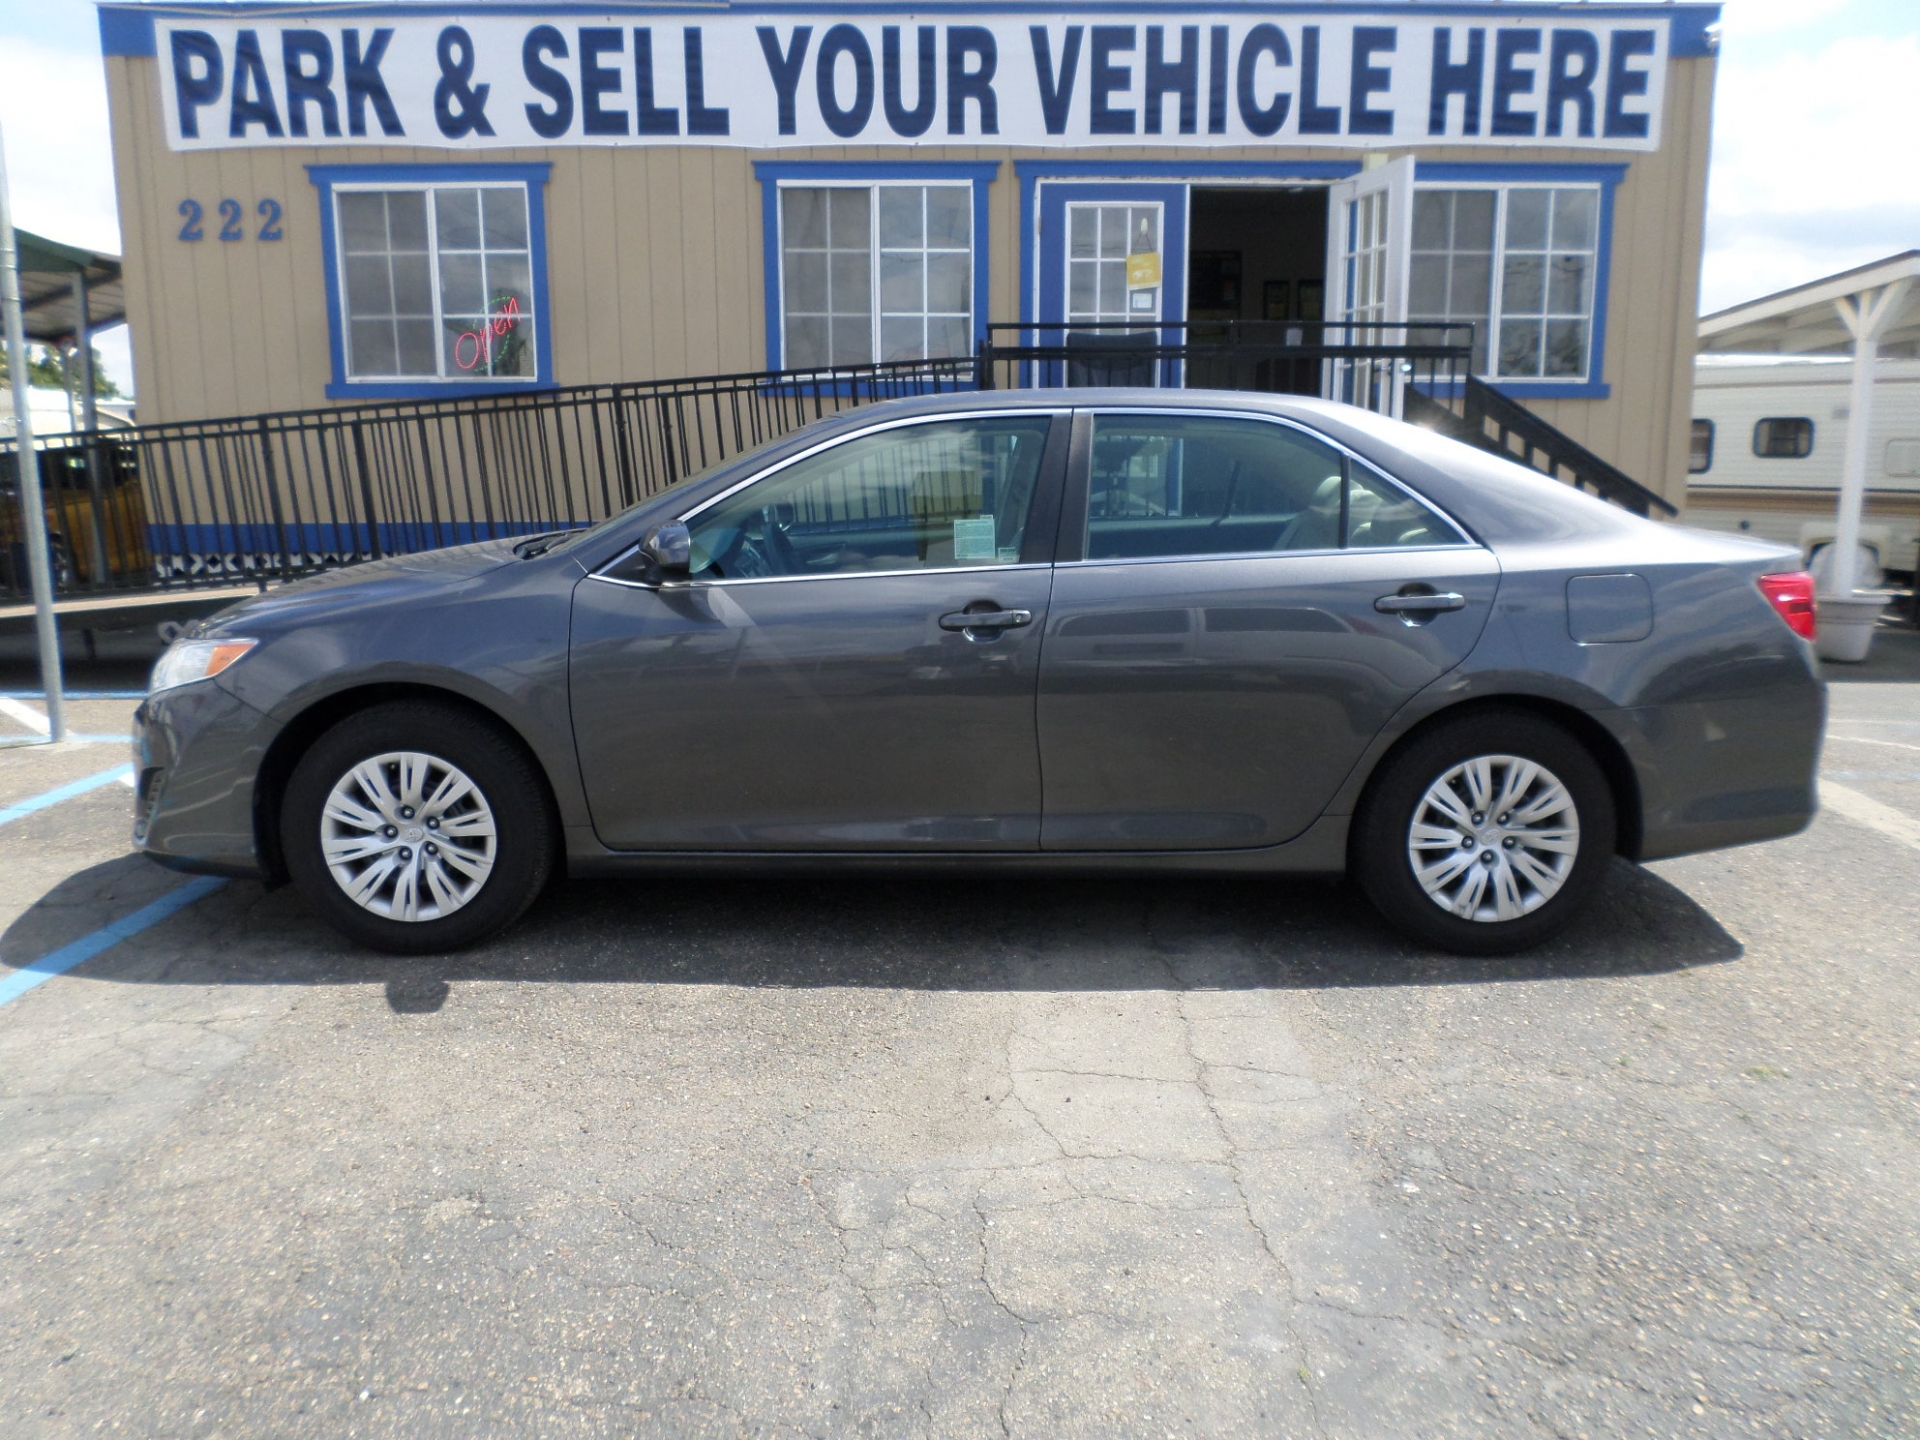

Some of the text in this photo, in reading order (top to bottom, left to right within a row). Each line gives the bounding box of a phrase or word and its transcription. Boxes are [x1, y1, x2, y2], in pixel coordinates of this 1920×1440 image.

[169, 23, 1656, 139] PARK & SELL YOUR VEHICLE HERE
[178, 199, 283, 241] 222
